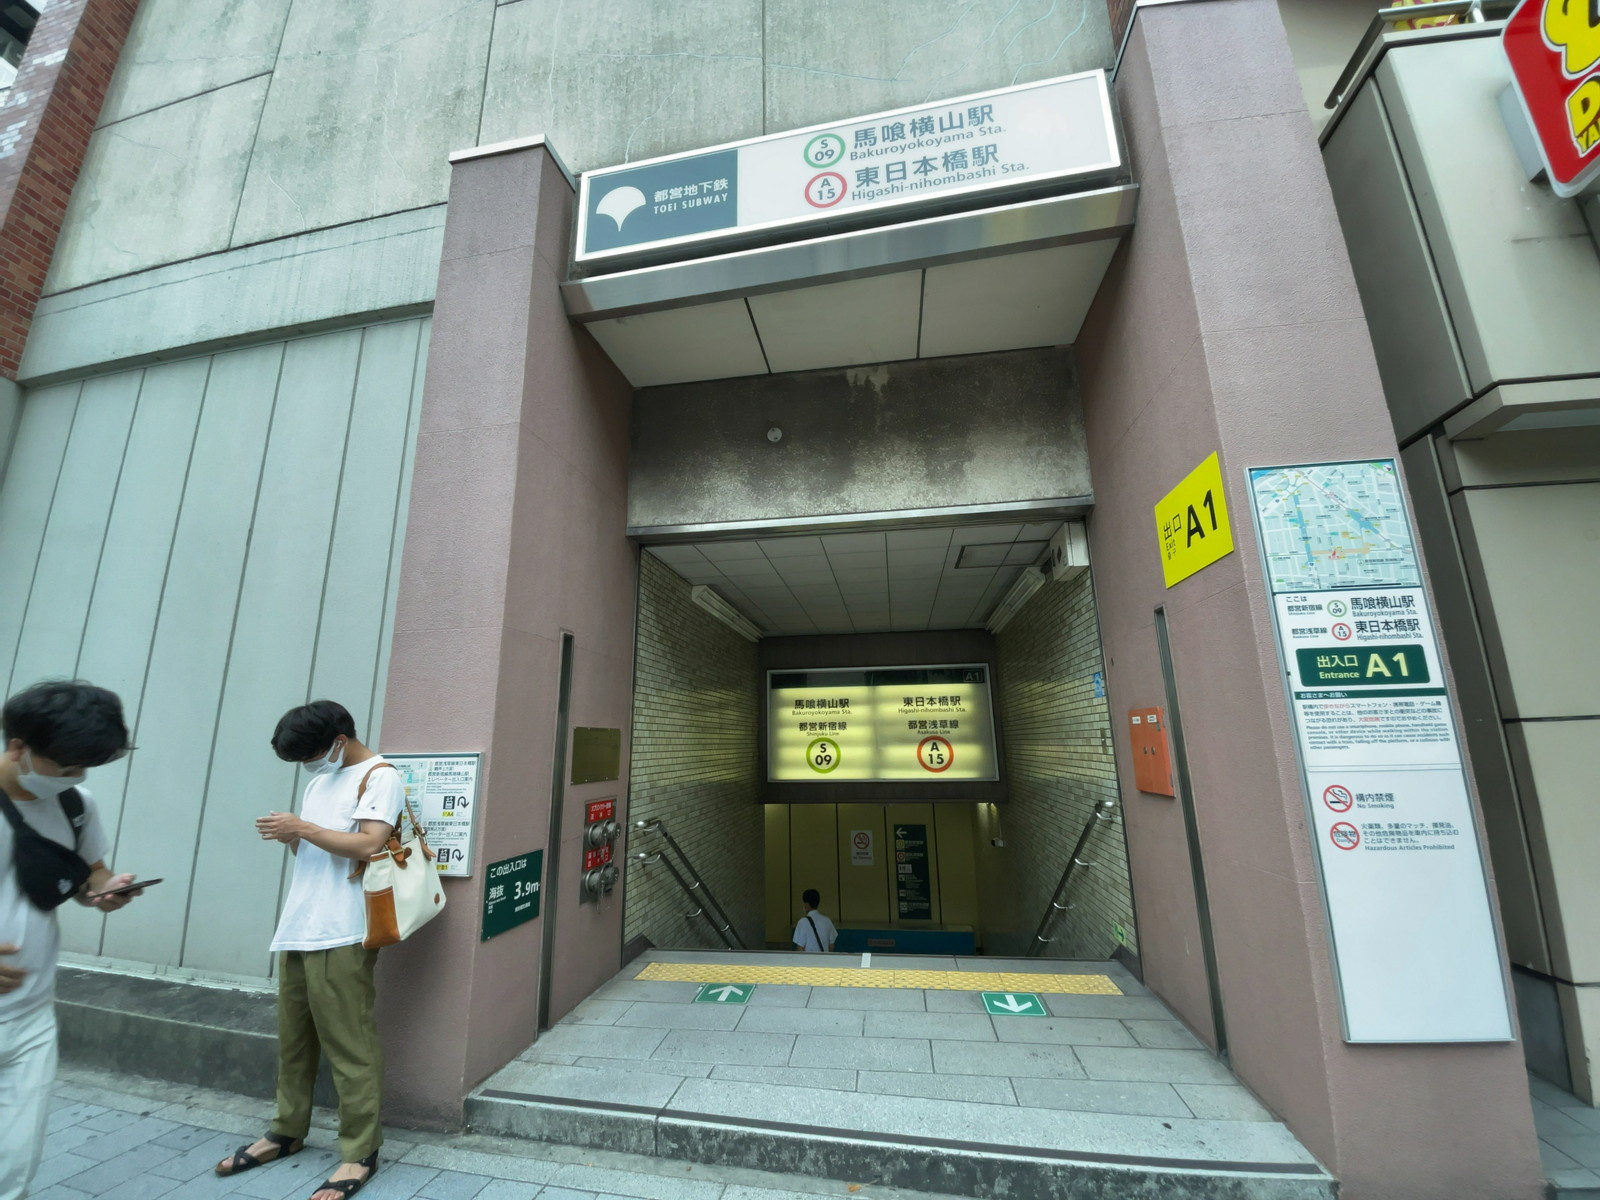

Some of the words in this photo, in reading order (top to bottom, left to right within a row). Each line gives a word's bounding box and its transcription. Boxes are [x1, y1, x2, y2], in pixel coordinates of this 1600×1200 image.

[854, 104, 994, 149] 馬喰横山駅
[820, 139, 828, 148] S
[850, 130, 974, 161] Bakuroyokoyama
[979, 124, 1006, 136] Sta.
[814, 149, 834, 162] 09
[855, 144, 999, 188] 東日本橋駅
[820, 178, 831, 188] A
[852, 168, 996, 201] Higashi-nihombashi
[1001, 162, 1030, 174] Sta.
[654, 178, 728, 202] 都営地下鉄
[818, 188, 836, 200] 15
[654, 202, 677, 214] TOEI
[682, 193, 728, 209] SUBWAY
[1186, 489, 1218, 548] A1
[1163, 513, 1182, 540] 出口
[1166, 540, 1176, 552] Exit
[1350, 596, 1416, 610] 馬喰横山駅
[1352, 610, 1405, 618] Bakuroyokoyama
[1354, 619, 1421, 634] 東日本橋駅
[1357, 633, 1412, 642] Higashi-nihombashi
[1317, 655, 1358, 668] 出入口
[1366, 652, 1409, 678] A1
[966, 671, 982, 681] A1
[1319, 671, 1360, 679] Entrance
[794, 698, 850, 709] 馬喰横山駅
[903, 696, 961, 707] 東日本橋駅
[799, 722, 847, 731] 都営新宿線
[908, 720, 959, 730] 都営浅草線
[820, 744, 827, 753] S
[930, 742, 939, 752] A
[815, 754, 832, 766] 09
[928, 754, 944, 765] 15
[1356, 793, 1394, 802] 構内禁煙
[490, 858, 528, 878] この出入口は
[488, 885, 504, 900] 海抜
[514, 881, 539, 900] 3.9m
